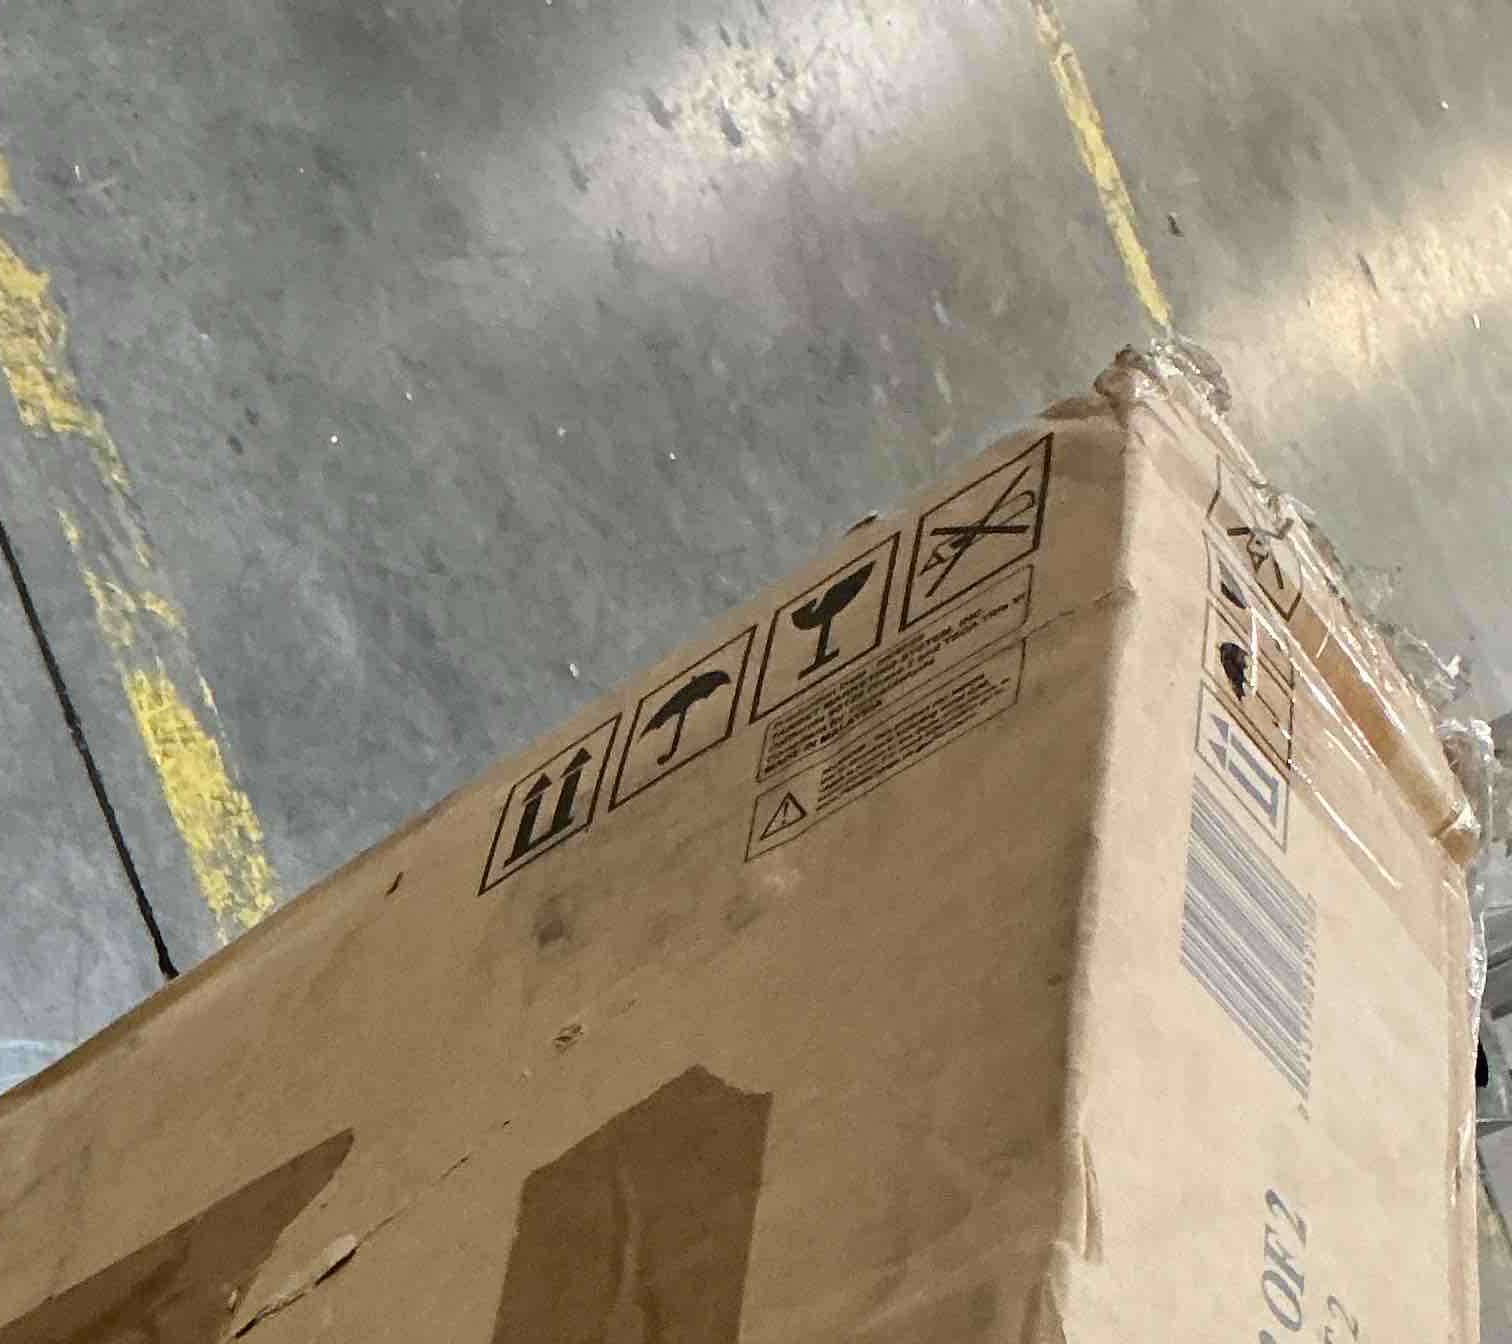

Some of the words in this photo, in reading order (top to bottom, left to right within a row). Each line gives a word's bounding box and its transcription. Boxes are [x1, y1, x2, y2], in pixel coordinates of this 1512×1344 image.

[1265, 1188, 1308, 1247] 2
[1261, 1226, 1306, 1334] OF
[1326, 1295, 1359, 1342] 2
